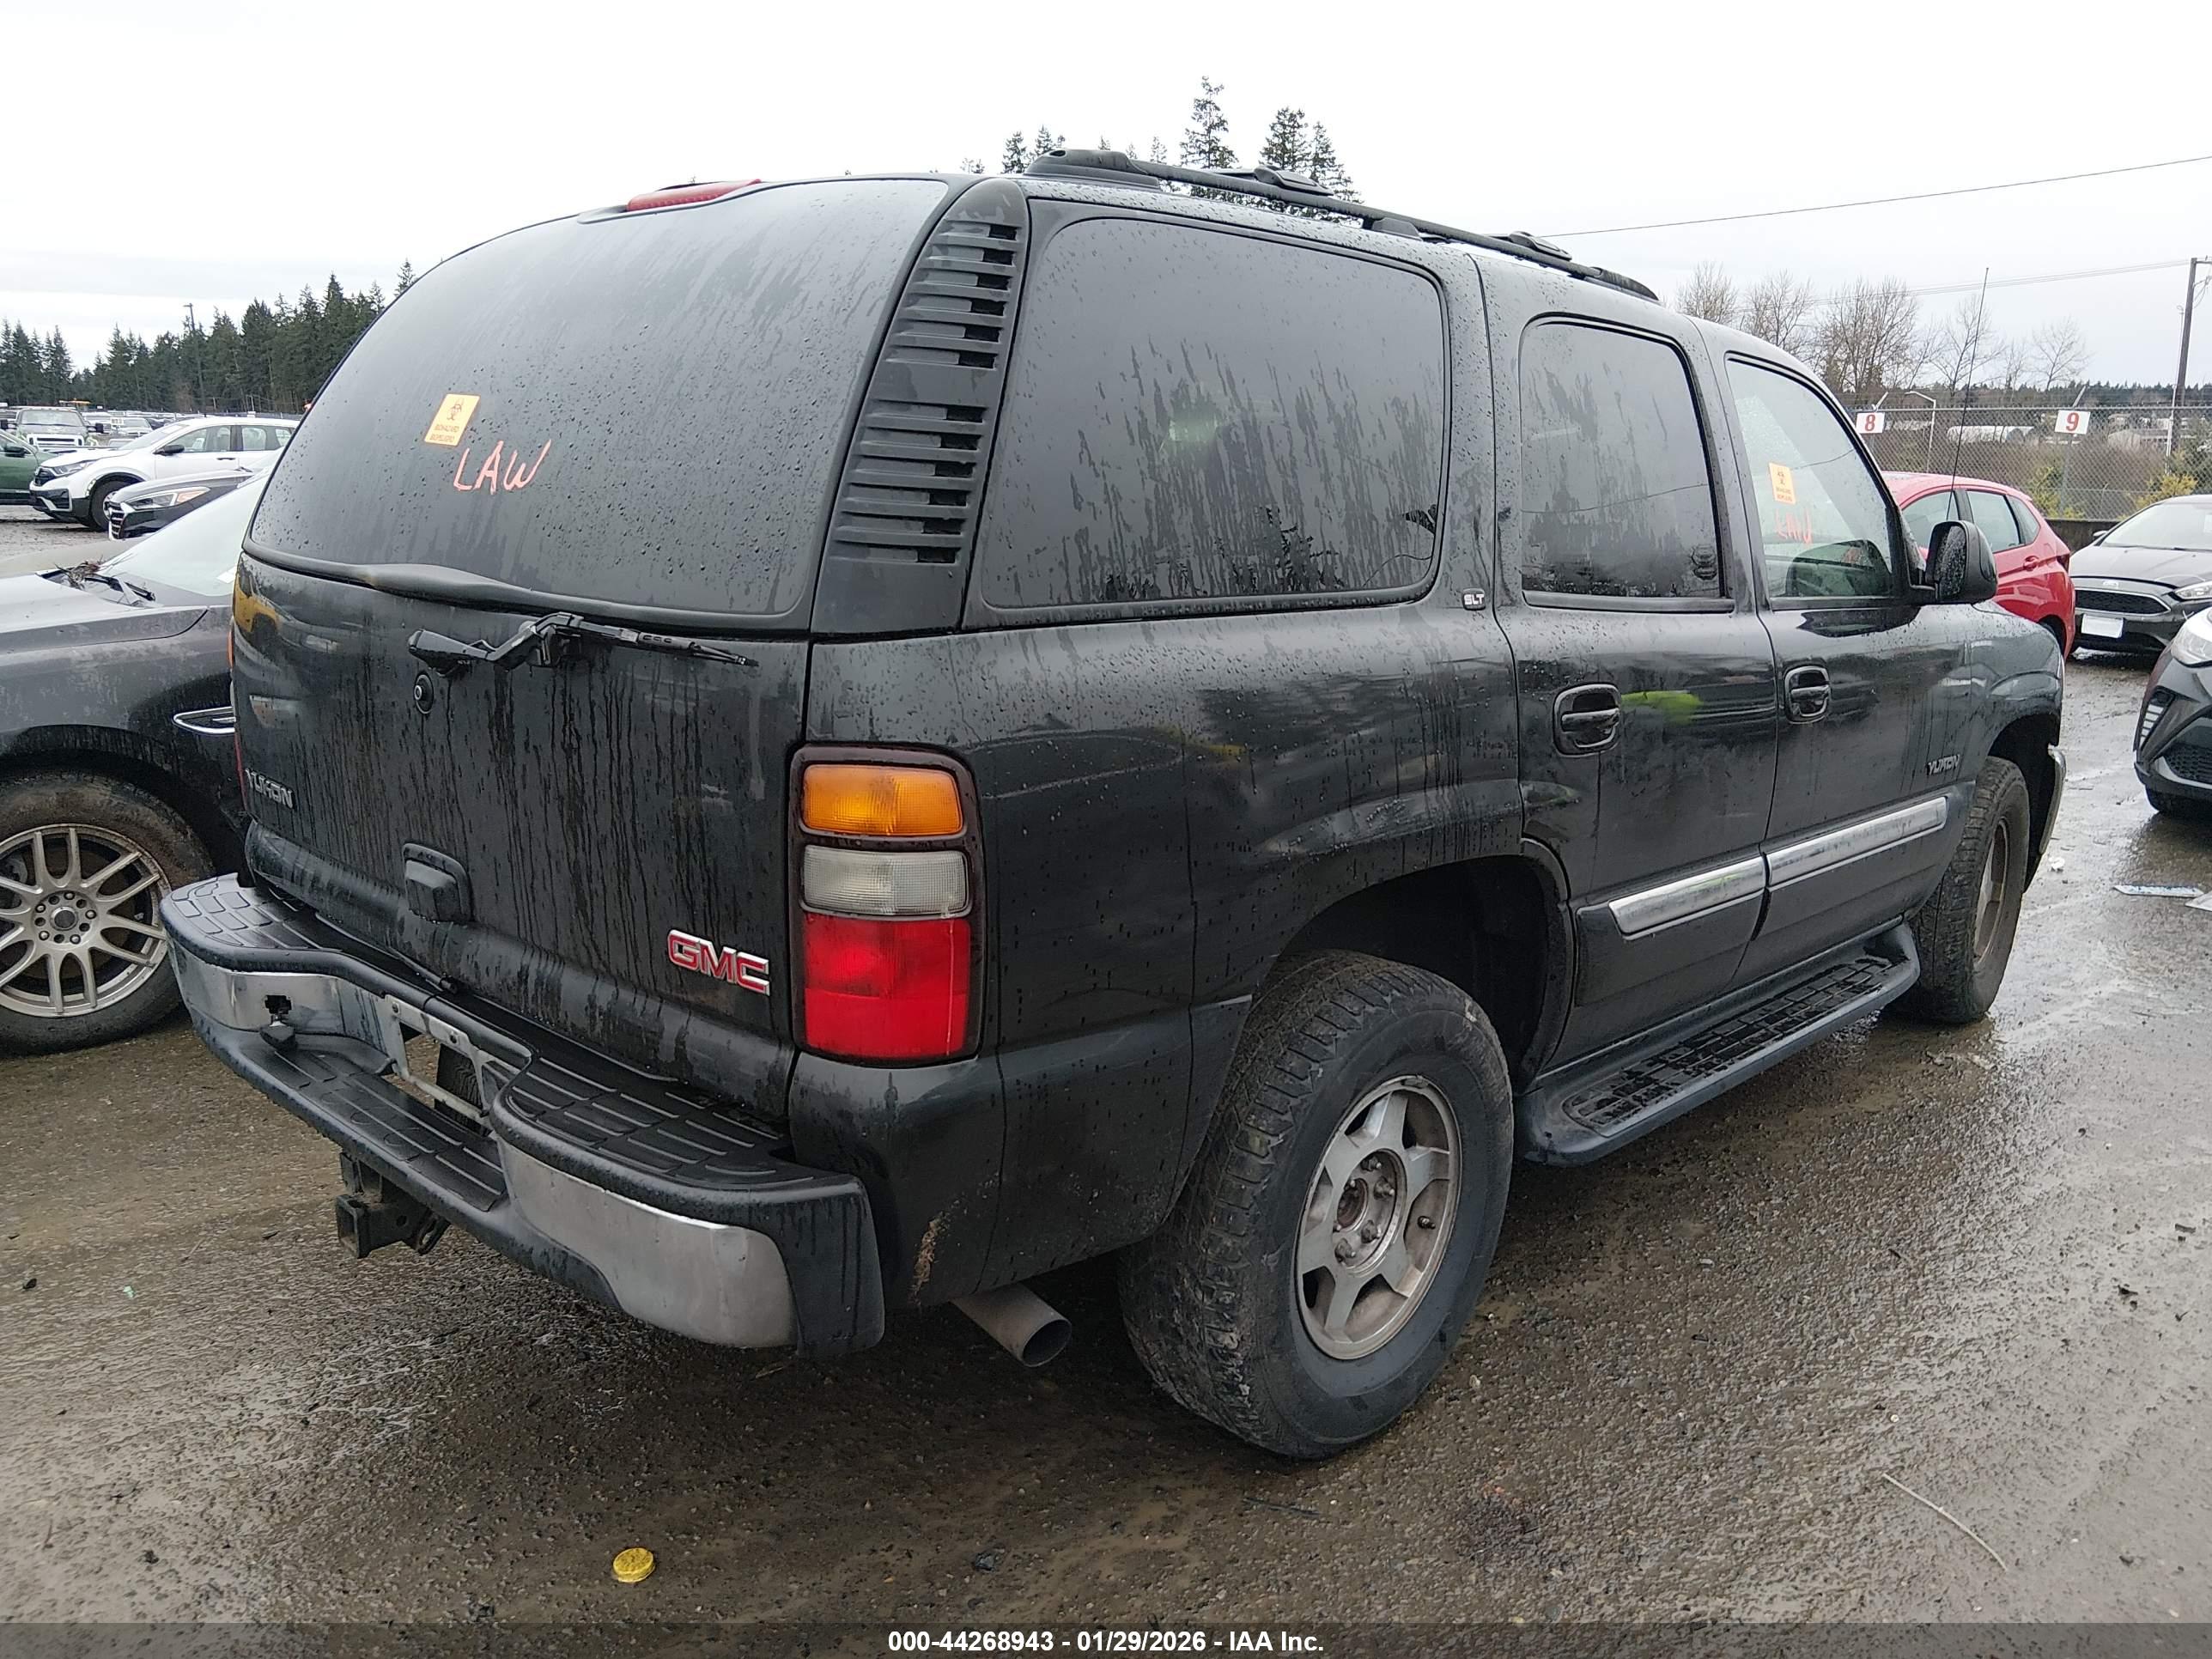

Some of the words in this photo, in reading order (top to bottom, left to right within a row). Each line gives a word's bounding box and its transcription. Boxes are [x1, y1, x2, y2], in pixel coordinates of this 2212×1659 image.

[1864, 414, 1876, 431] 8
[2065, 412, 2080, 431] 9
[453, 439, 552, 495] LAW
[1463, 593, 1485, 605] SLT
[1928, 754, 1961, 775] YUKON
[245, 768, 294, 809] YUKON
[667, 929, 770, 996] GMC
